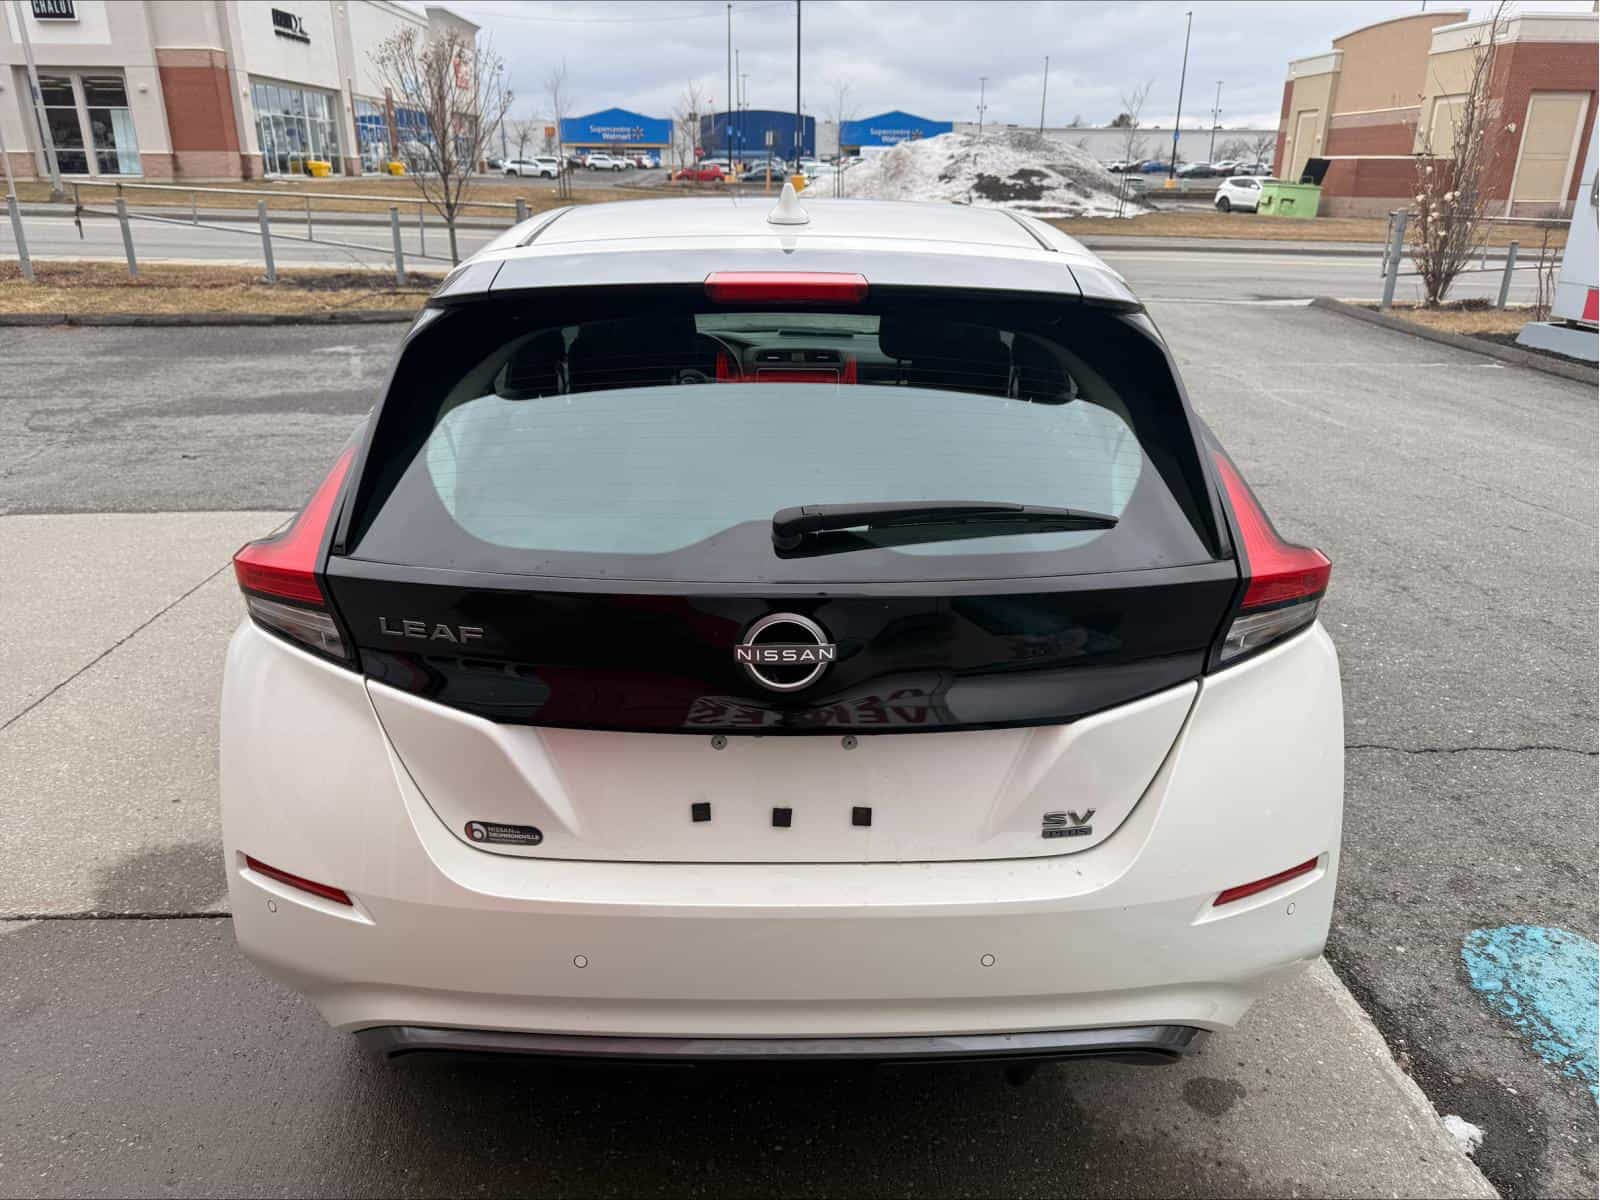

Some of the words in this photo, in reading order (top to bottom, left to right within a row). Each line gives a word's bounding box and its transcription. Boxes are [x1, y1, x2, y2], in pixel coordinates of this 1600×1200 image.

[602, 132, 632, 141] Walmart
[379, 616, 485, 643] LEAF
[737, 648, 833, 661] NISSAN
[1042, 808, 1096, 827] SV
